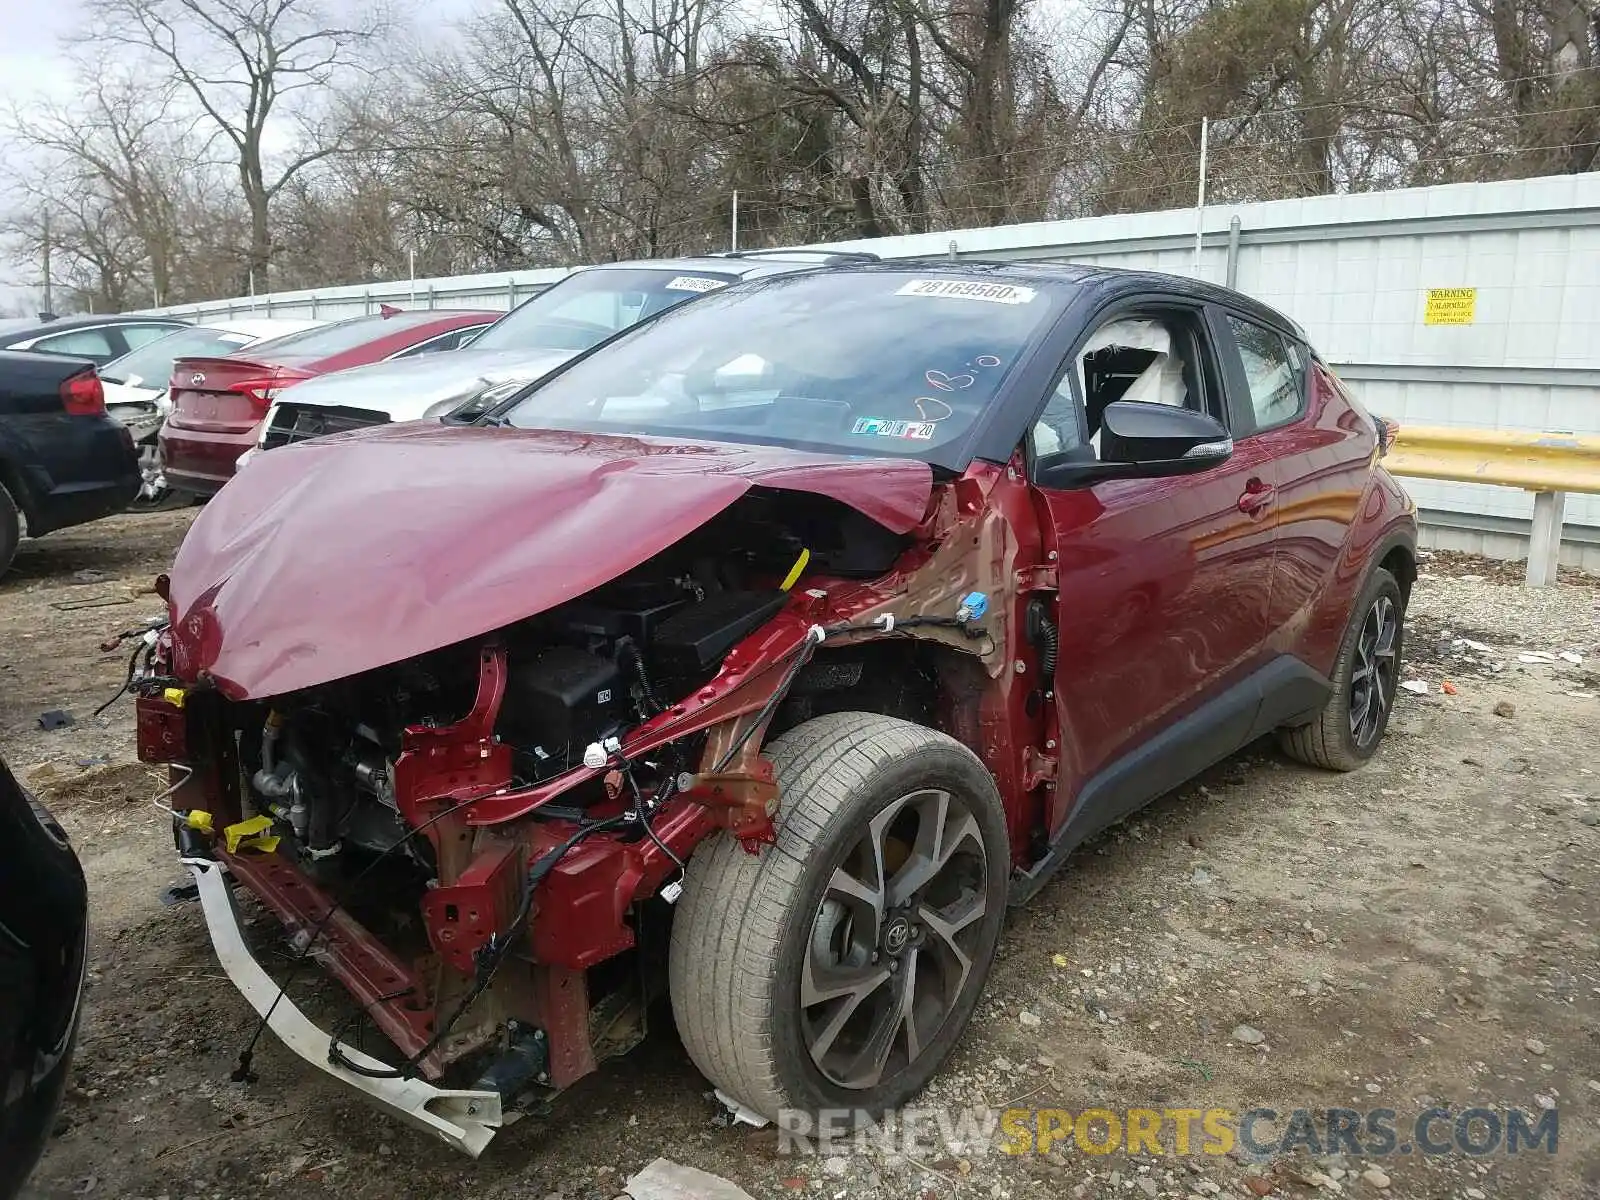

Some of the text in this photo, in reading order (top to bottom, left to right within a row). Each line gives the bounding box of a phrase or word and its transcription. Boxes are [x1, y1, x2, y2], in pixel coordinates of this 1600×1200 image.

[1431, 289, 1473, 298] WARNING
[880, 421, 893, 433] 20
[919, 424, 932, 436] 20
